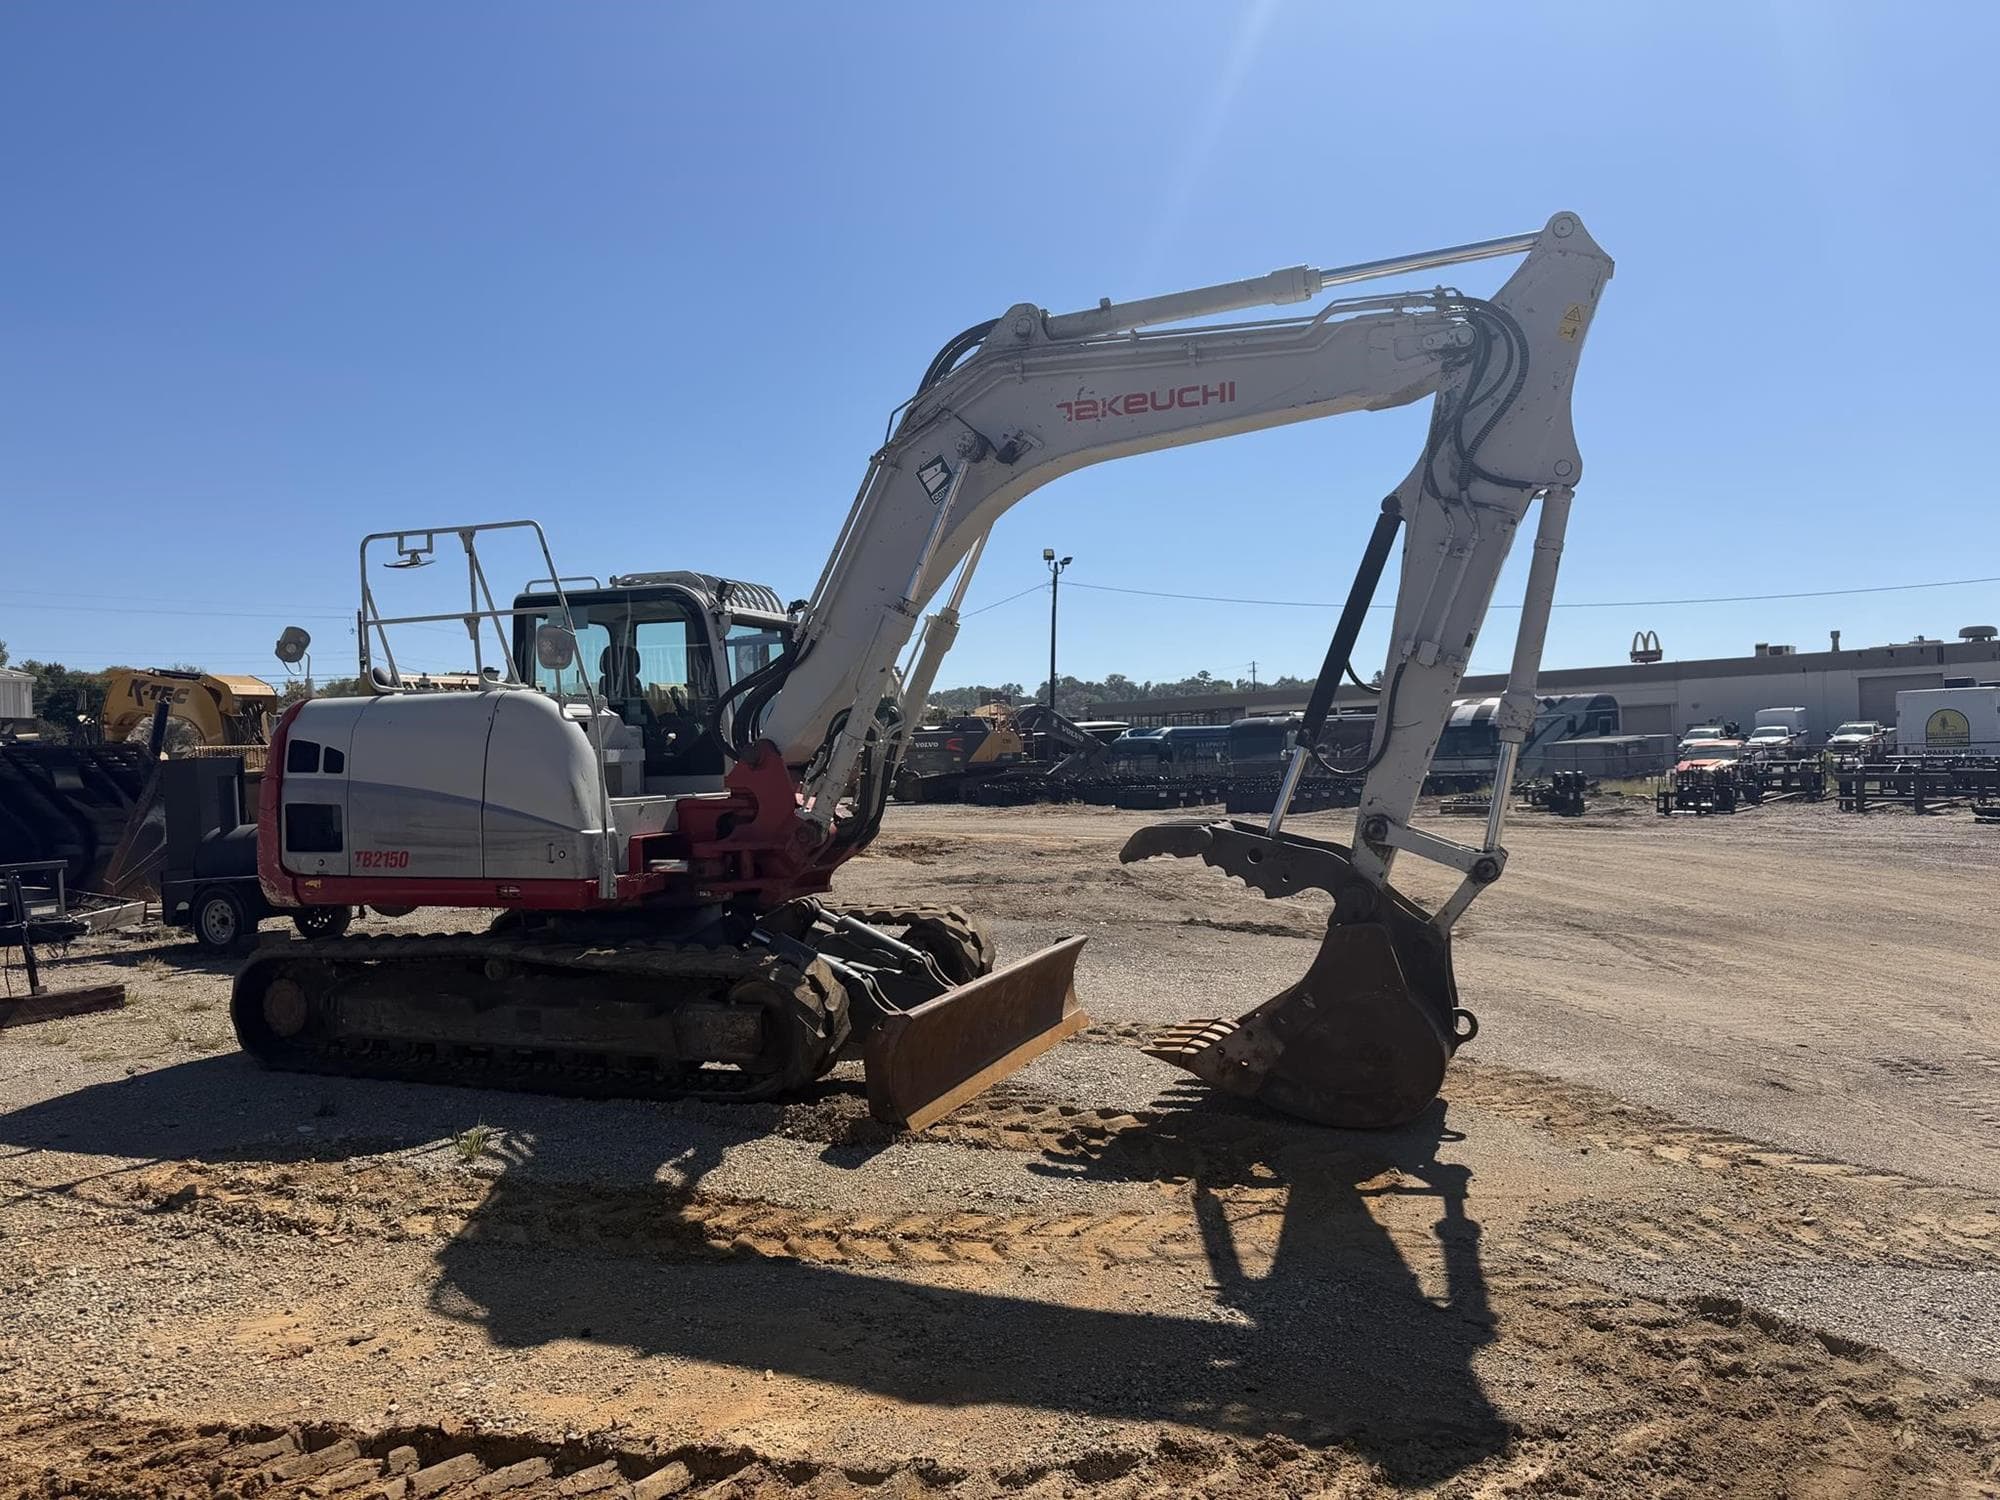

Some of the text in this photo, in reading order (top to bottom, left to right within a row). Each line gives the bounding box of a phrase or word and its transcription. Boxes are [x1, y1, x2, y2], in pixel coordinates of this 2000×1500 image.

[127, 679, 191, 707] K-TEC
[1061, 724, 1085, 743] VOLVO
[354, 850, 410, 868] TB2150
